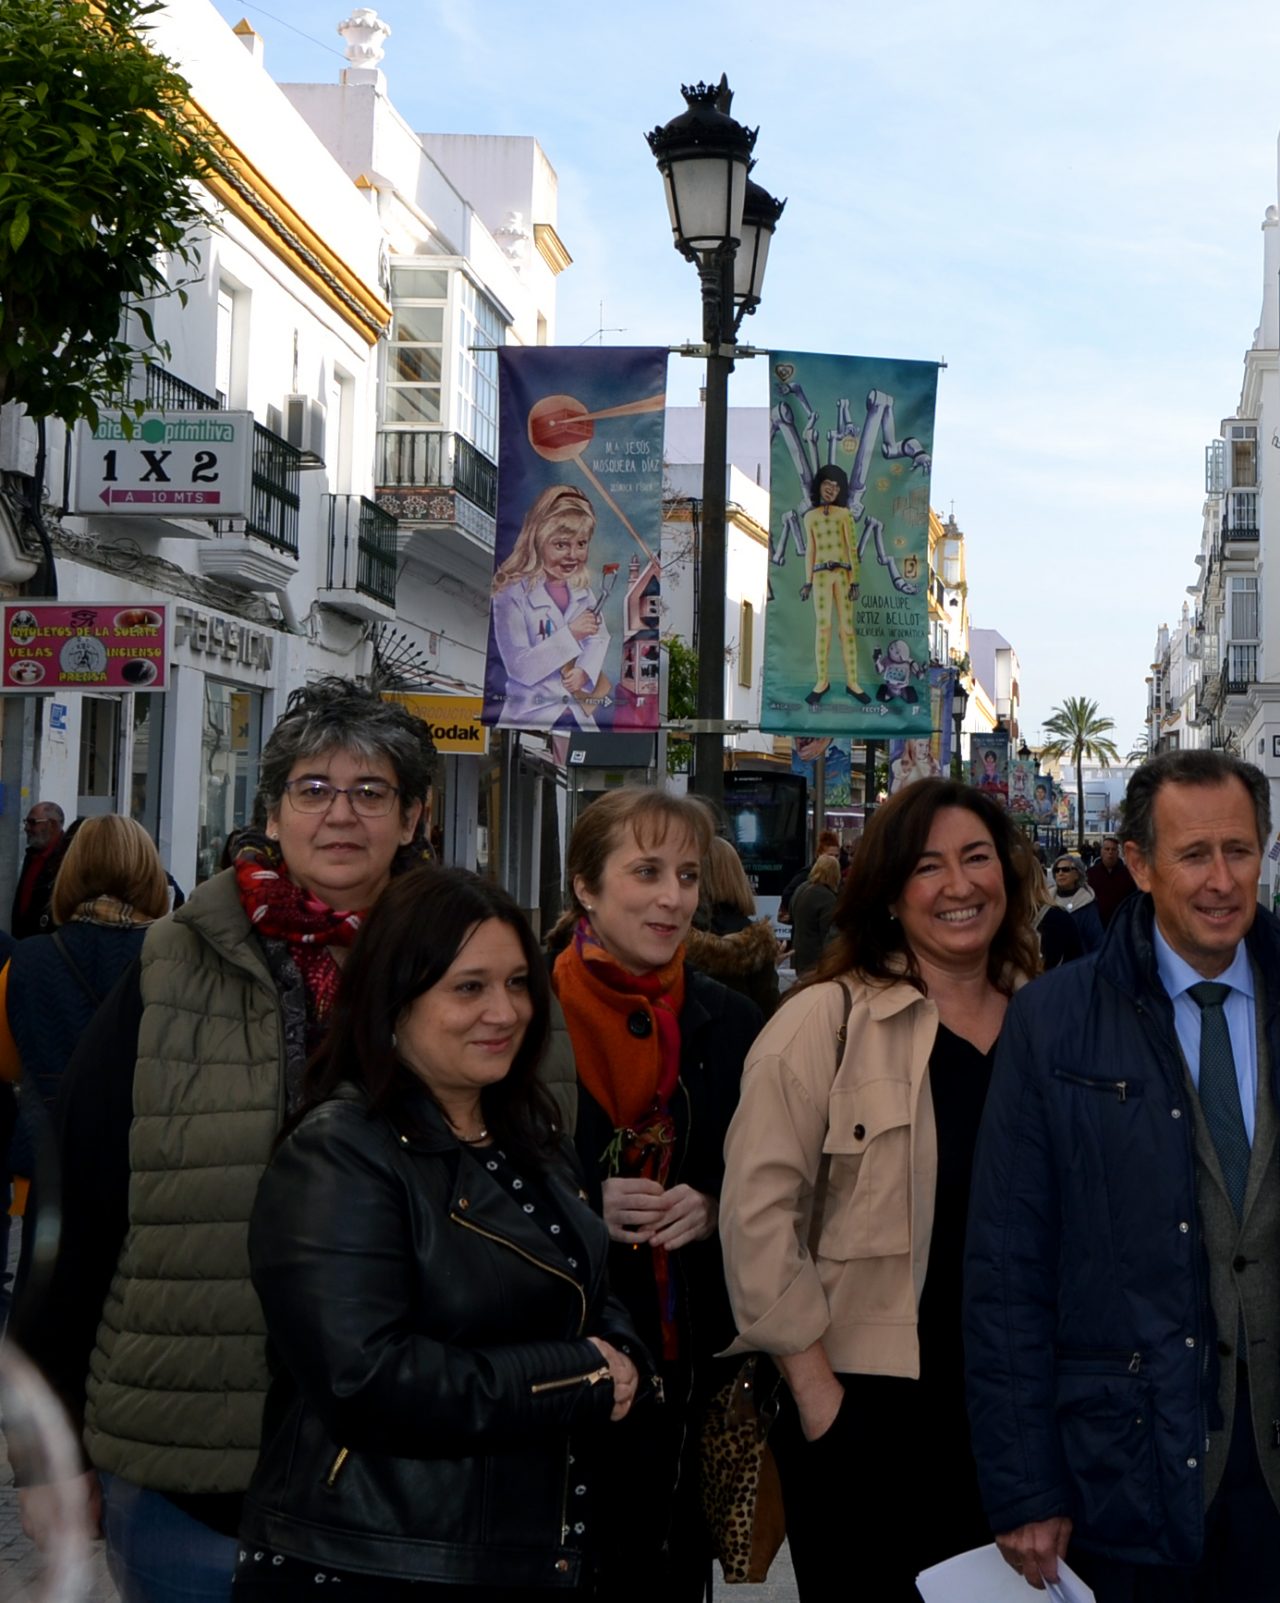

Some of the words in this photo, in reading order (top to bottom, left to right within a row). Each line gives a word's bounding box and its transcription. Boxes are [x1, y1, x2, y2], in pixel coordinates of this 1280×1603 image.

[92, 418, 143, 440] otea
[164, 418, 234, 443] primitiva
[625, 440, 651, 455] JESÚS
[102, 449, 118, 481] 1
[139, 450, 172, 482] X
[191, 450, 219, 483] 2
[593, 459, 636, 472] MOSQUERA
[641, 457, 660, 472] DÍAZ
[125, 491, 134, 502] A
[152, 492, 167, 502] 10
[861, 595, 911, 610] GUADALUPE
[856, 611, 880, 625] ORTIZ
[886, 611, 921, 627] BELLOT
[12, 626, 73, 638] AMULETOS
[77, 627, 91, 637] DE
[95, 627, 109, 637] LA
[114, 626, 158, 638] SUERTE
[8, 647, 53, 658] VELAS
[106, 647, 161, 658] INCIENSO
[59, 672, 107, 682] PRENSA
